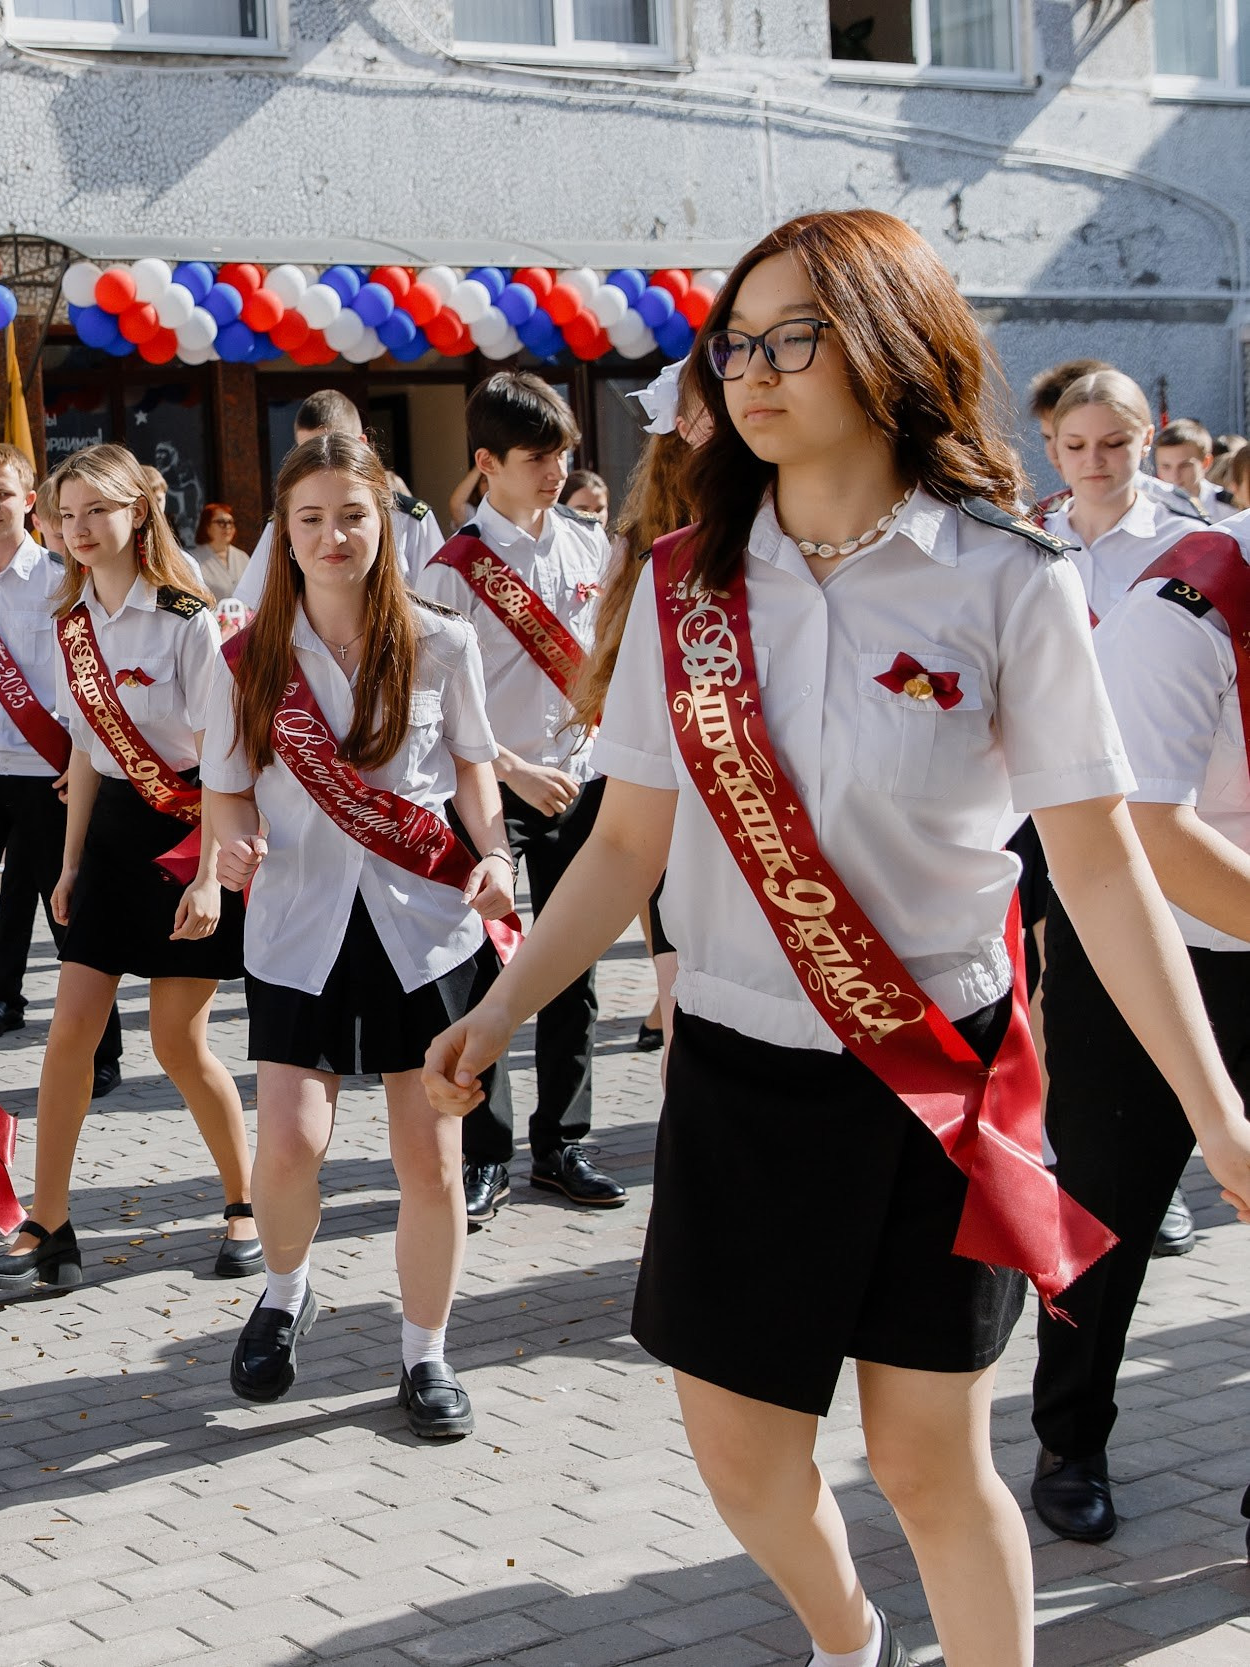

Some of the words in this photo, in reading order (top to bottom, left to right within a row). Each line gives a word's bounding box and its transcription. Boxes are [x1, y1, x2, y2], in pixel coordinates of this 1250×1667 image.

[411, 500, 429, 518] 33
[126, 760, 160, 780] 9
[273, 708, 400, 836] Выпускница
[762, 877, 836, 917] 9
